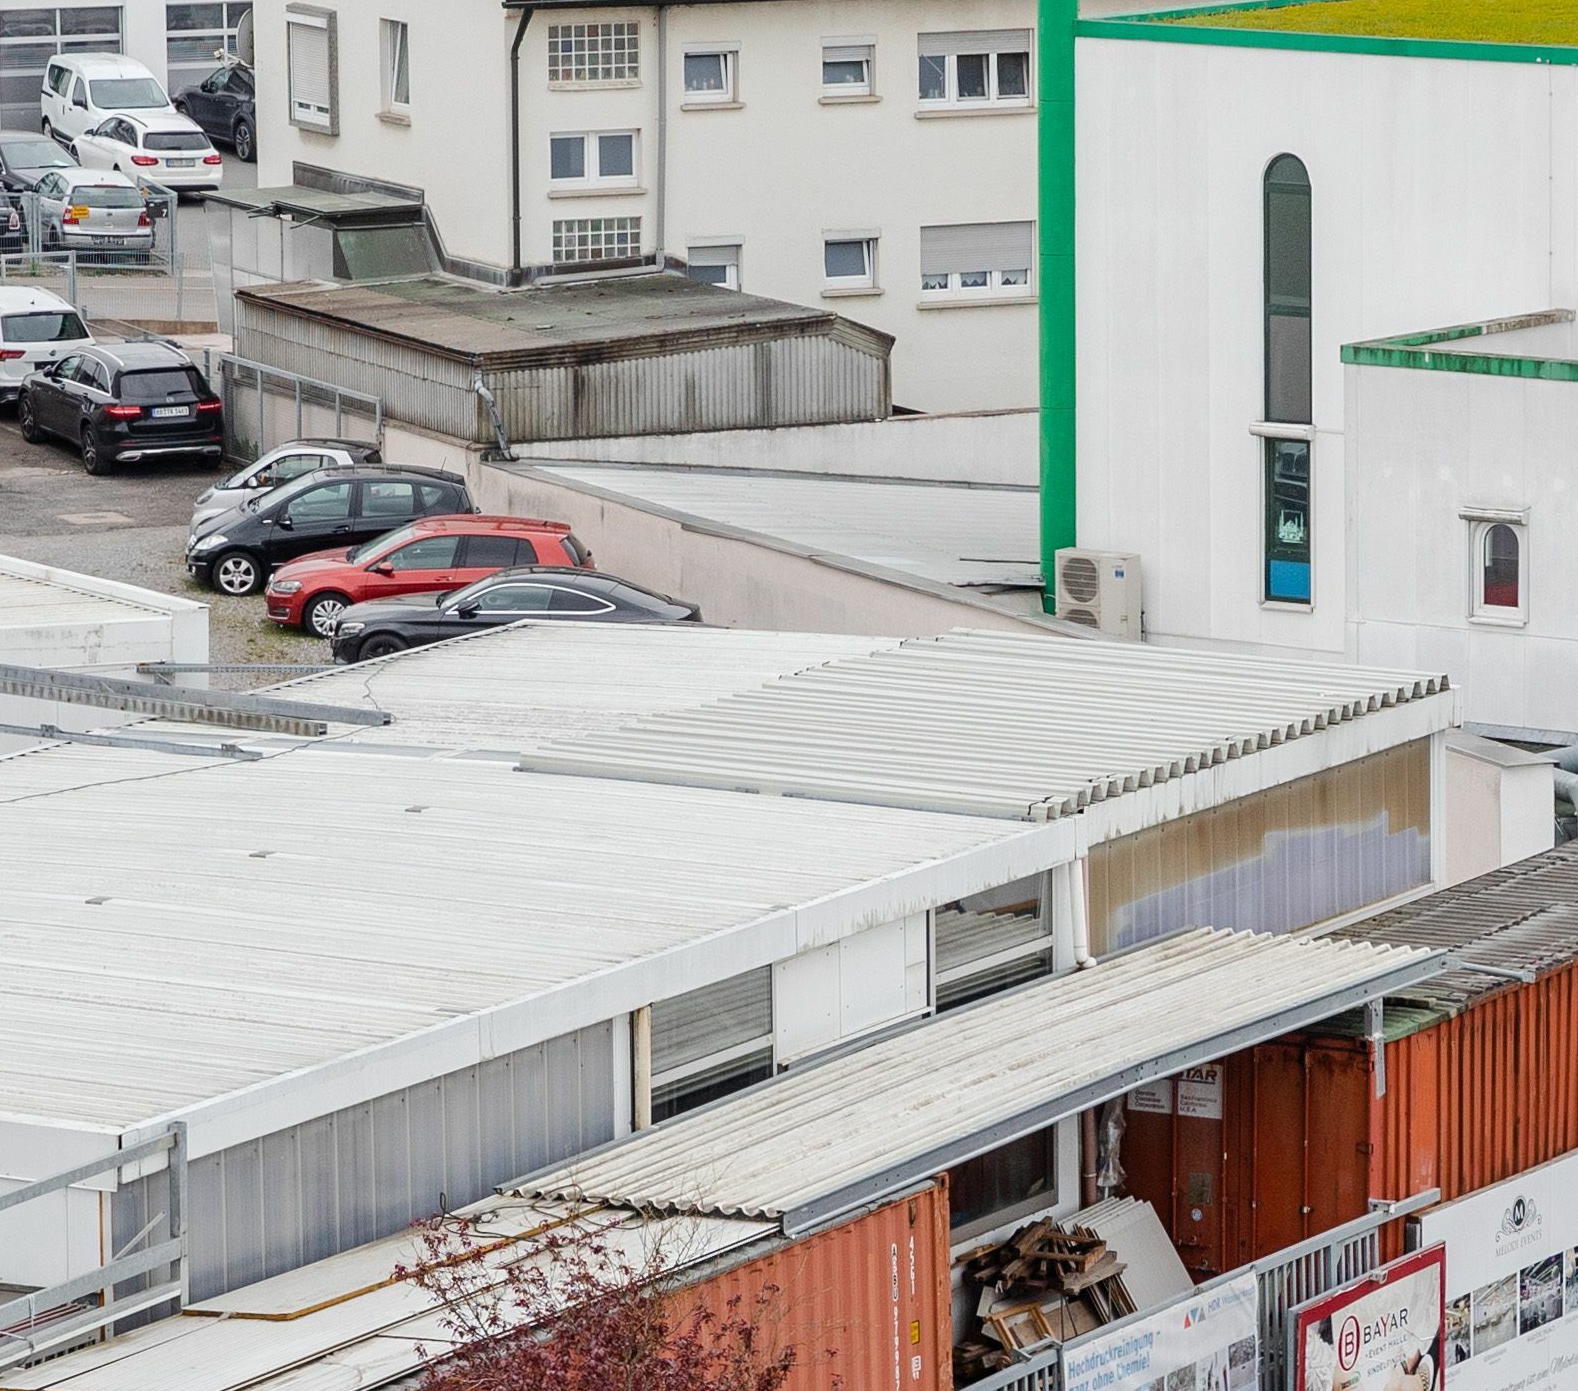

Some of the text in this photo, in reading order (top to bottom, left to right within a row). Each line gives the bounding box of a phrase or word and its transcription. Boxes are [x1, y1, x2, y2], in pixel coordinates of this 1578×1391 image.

[1344, 1331, 1355, 1358] B
[1363, 1308, 1409, 1345] BAYAR
[1068, 1331, 1154, 1380] Hochdruckreinigung
[1092, 1369, 1114, 1390] ohne
[1116, 1351, 1151, 1381] Chemie!
